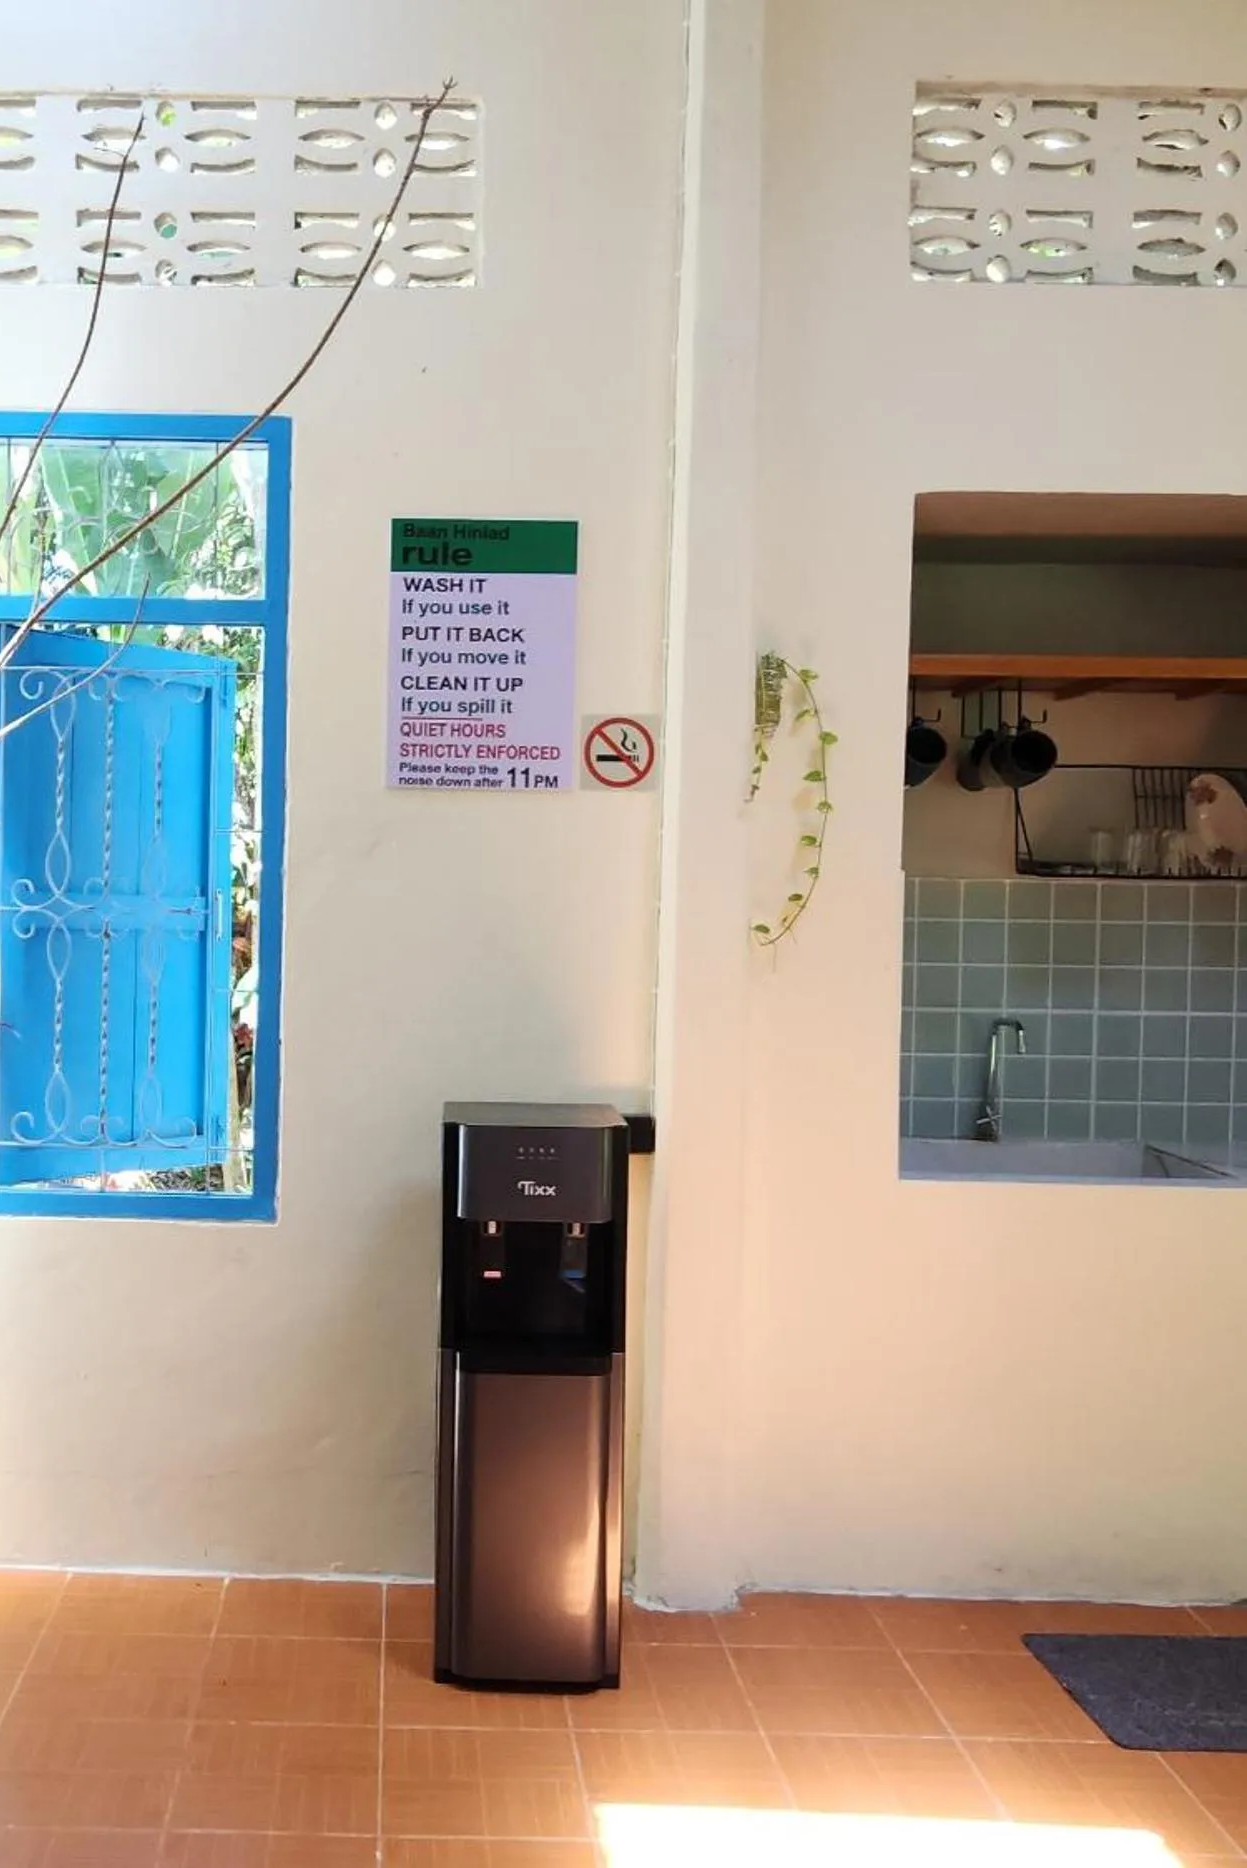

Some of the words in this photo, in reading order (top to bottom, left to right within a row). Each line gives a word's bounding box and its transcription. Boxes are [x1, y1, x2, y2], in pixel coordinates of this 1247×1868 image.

[404, 524, 448, 538] Baan
[403, 543, 473, 566] rule
[404, 577, 463, 593] WASH
[470, 578, 487, 593] IT
[402, 599, 413, 614] If
[418, 602, 453, 618] you
[458, 602, 493, 615] use
[497, 600, 510, 615] it
[402, 626, 441, 641] PUT
[447, 627, 464, 641] IT
[469, 628, 525, 643] BACK
[402, 648, 413, 664] If
[418, 651, 452, 667] you
[457, 652, 509, 665] move
[514, 650, 526, 665] it
[401, 676, 467, 691] CLEAN
[474, 677, 490, 691] IT
[496, 677, 524, 692] UP
[401, 698, 413, 713] If
[418, 700, 452, 716] you
[457, 699, 495, 717] spill
[500, 699, 513, 714] it
[400, 722, 447, 738] QUIET
[450, 723, 507, 738] HOURS
[399, 743, 472, 759] STRICTLY
[476, 744, 560, 760] ENFORCED
[399, 762, 441, 774] Please
[445, 763, 477, 777] keep
[480, 764, 499, 775] the
[399, 777, 432, 786] noise
[435, 776, 471, 787] down
[474, 777, 503, 788] after
[507, 768, 531, 788] 11
[534, 774, 559, 788] PM
[517, 1181, 557, 1196] Tixx
